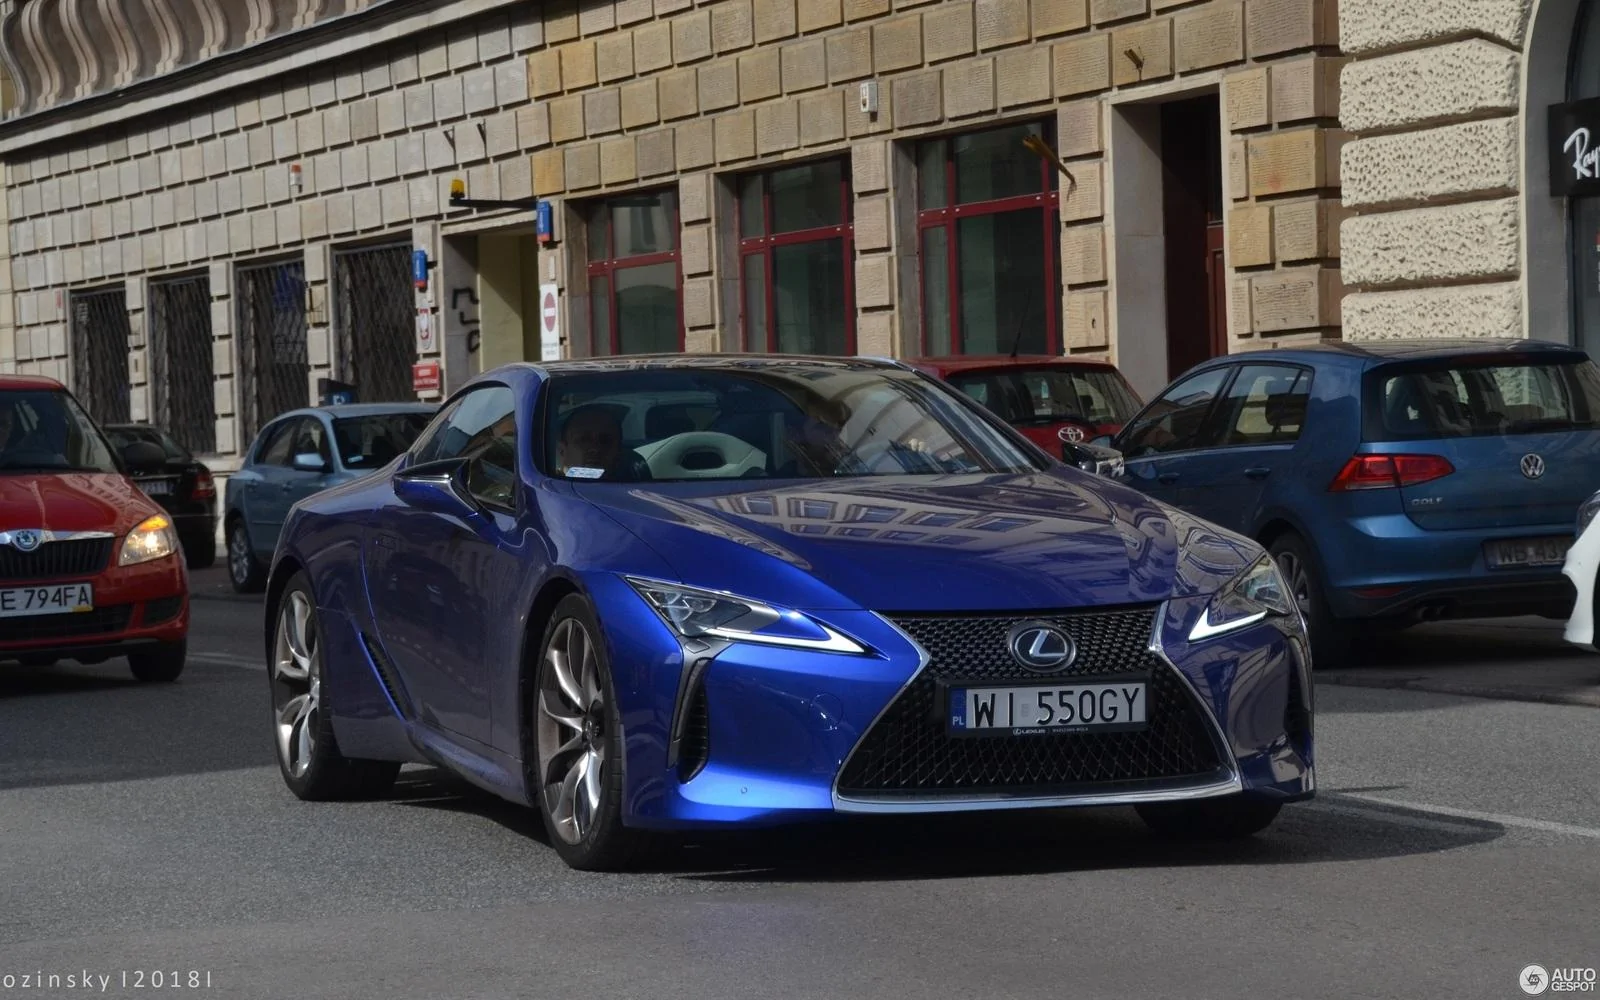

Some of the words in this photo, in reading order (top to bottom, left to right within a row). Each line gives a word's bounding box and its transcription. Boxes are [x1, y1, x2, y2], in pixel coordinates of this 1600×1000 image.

[1411, 496, 1444, 506] GOLF
[0, 589, 17, 611] E
[24, 585, 90, 609] 794FA
[973, 692, 1014, 728] WI
[1037, 687, 1140, 725] 550GY
[952, 715, 965, 726] PL
